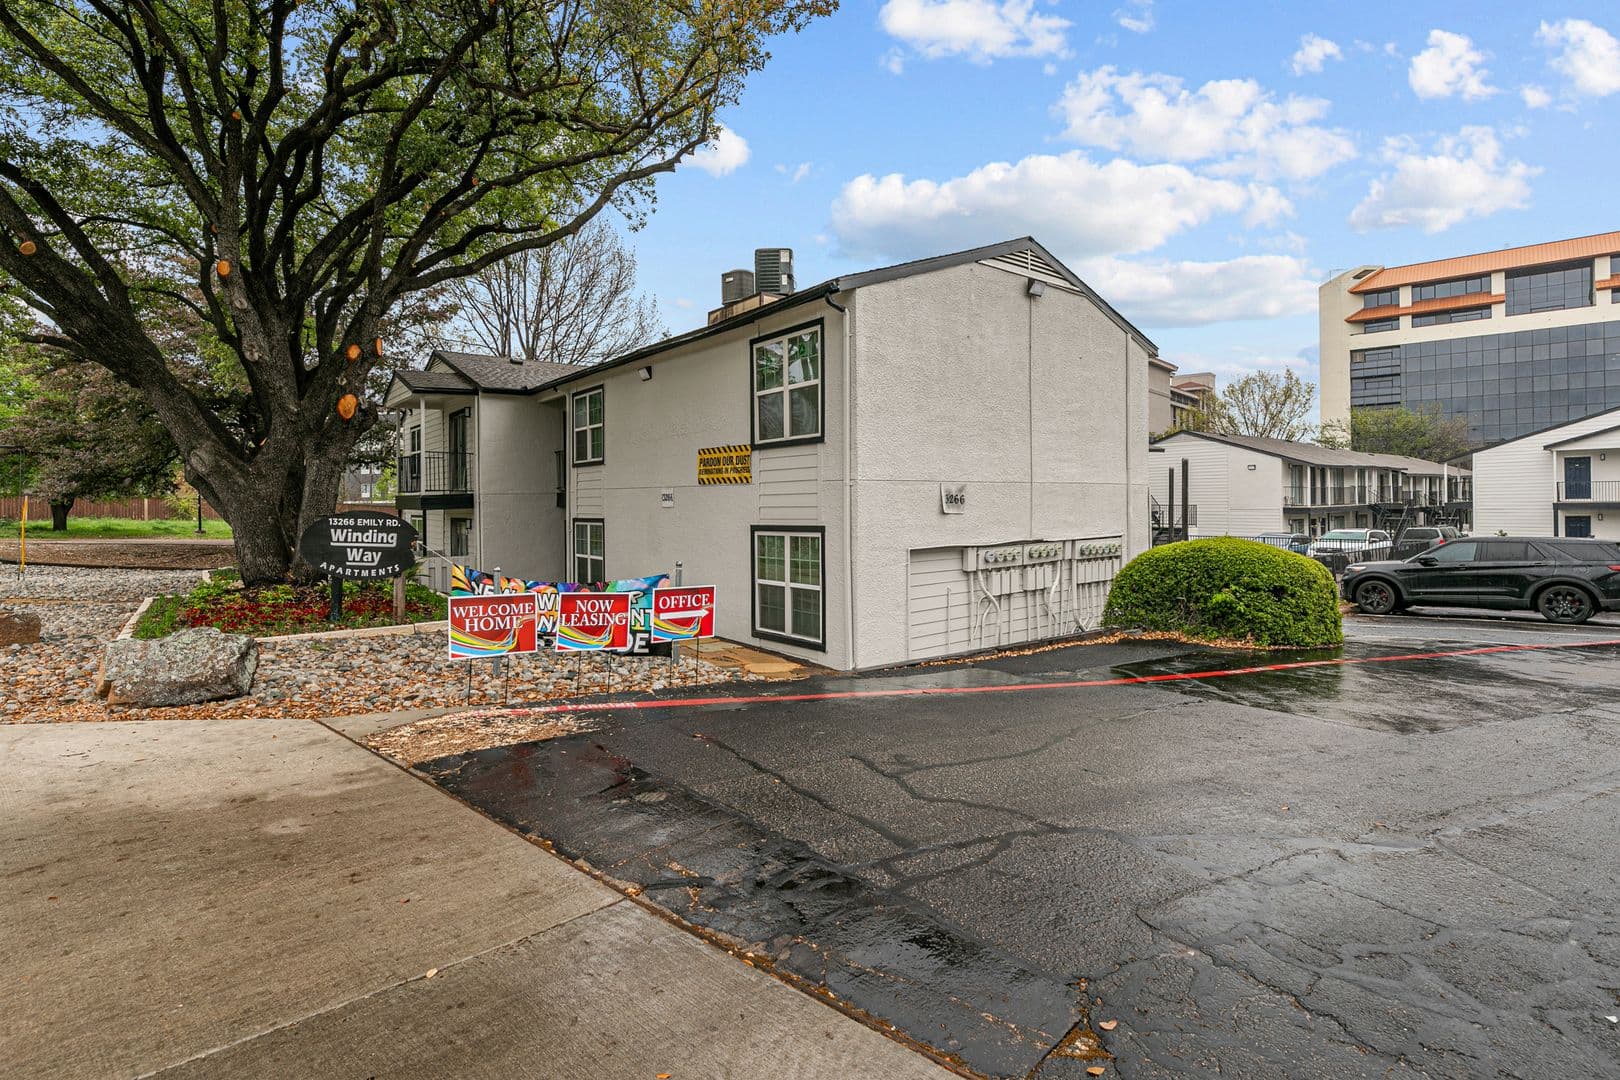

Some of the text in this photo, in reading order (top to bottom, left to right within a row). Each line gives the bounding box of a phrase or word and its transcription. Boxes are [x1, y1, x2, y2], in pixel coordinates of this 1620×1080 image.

[700, 458, 721, 467] PARDON
[723, 456, 734, 466] OUR
[328, 518, 401, 527] 13266 EMILY RD.
[330, 528, 397, 547] Winding
[346, 548, 382, 566] Way
[320, 561, 400, 577] APARTMENTS
[575, 600, 614, 613] NOW
[659, 593, 710, 609] OFFICE
[453, 602, 534, 618] WELCOME
[464, 615, 523, 632] HOME
[561, 612, 626, 626] LEASING
